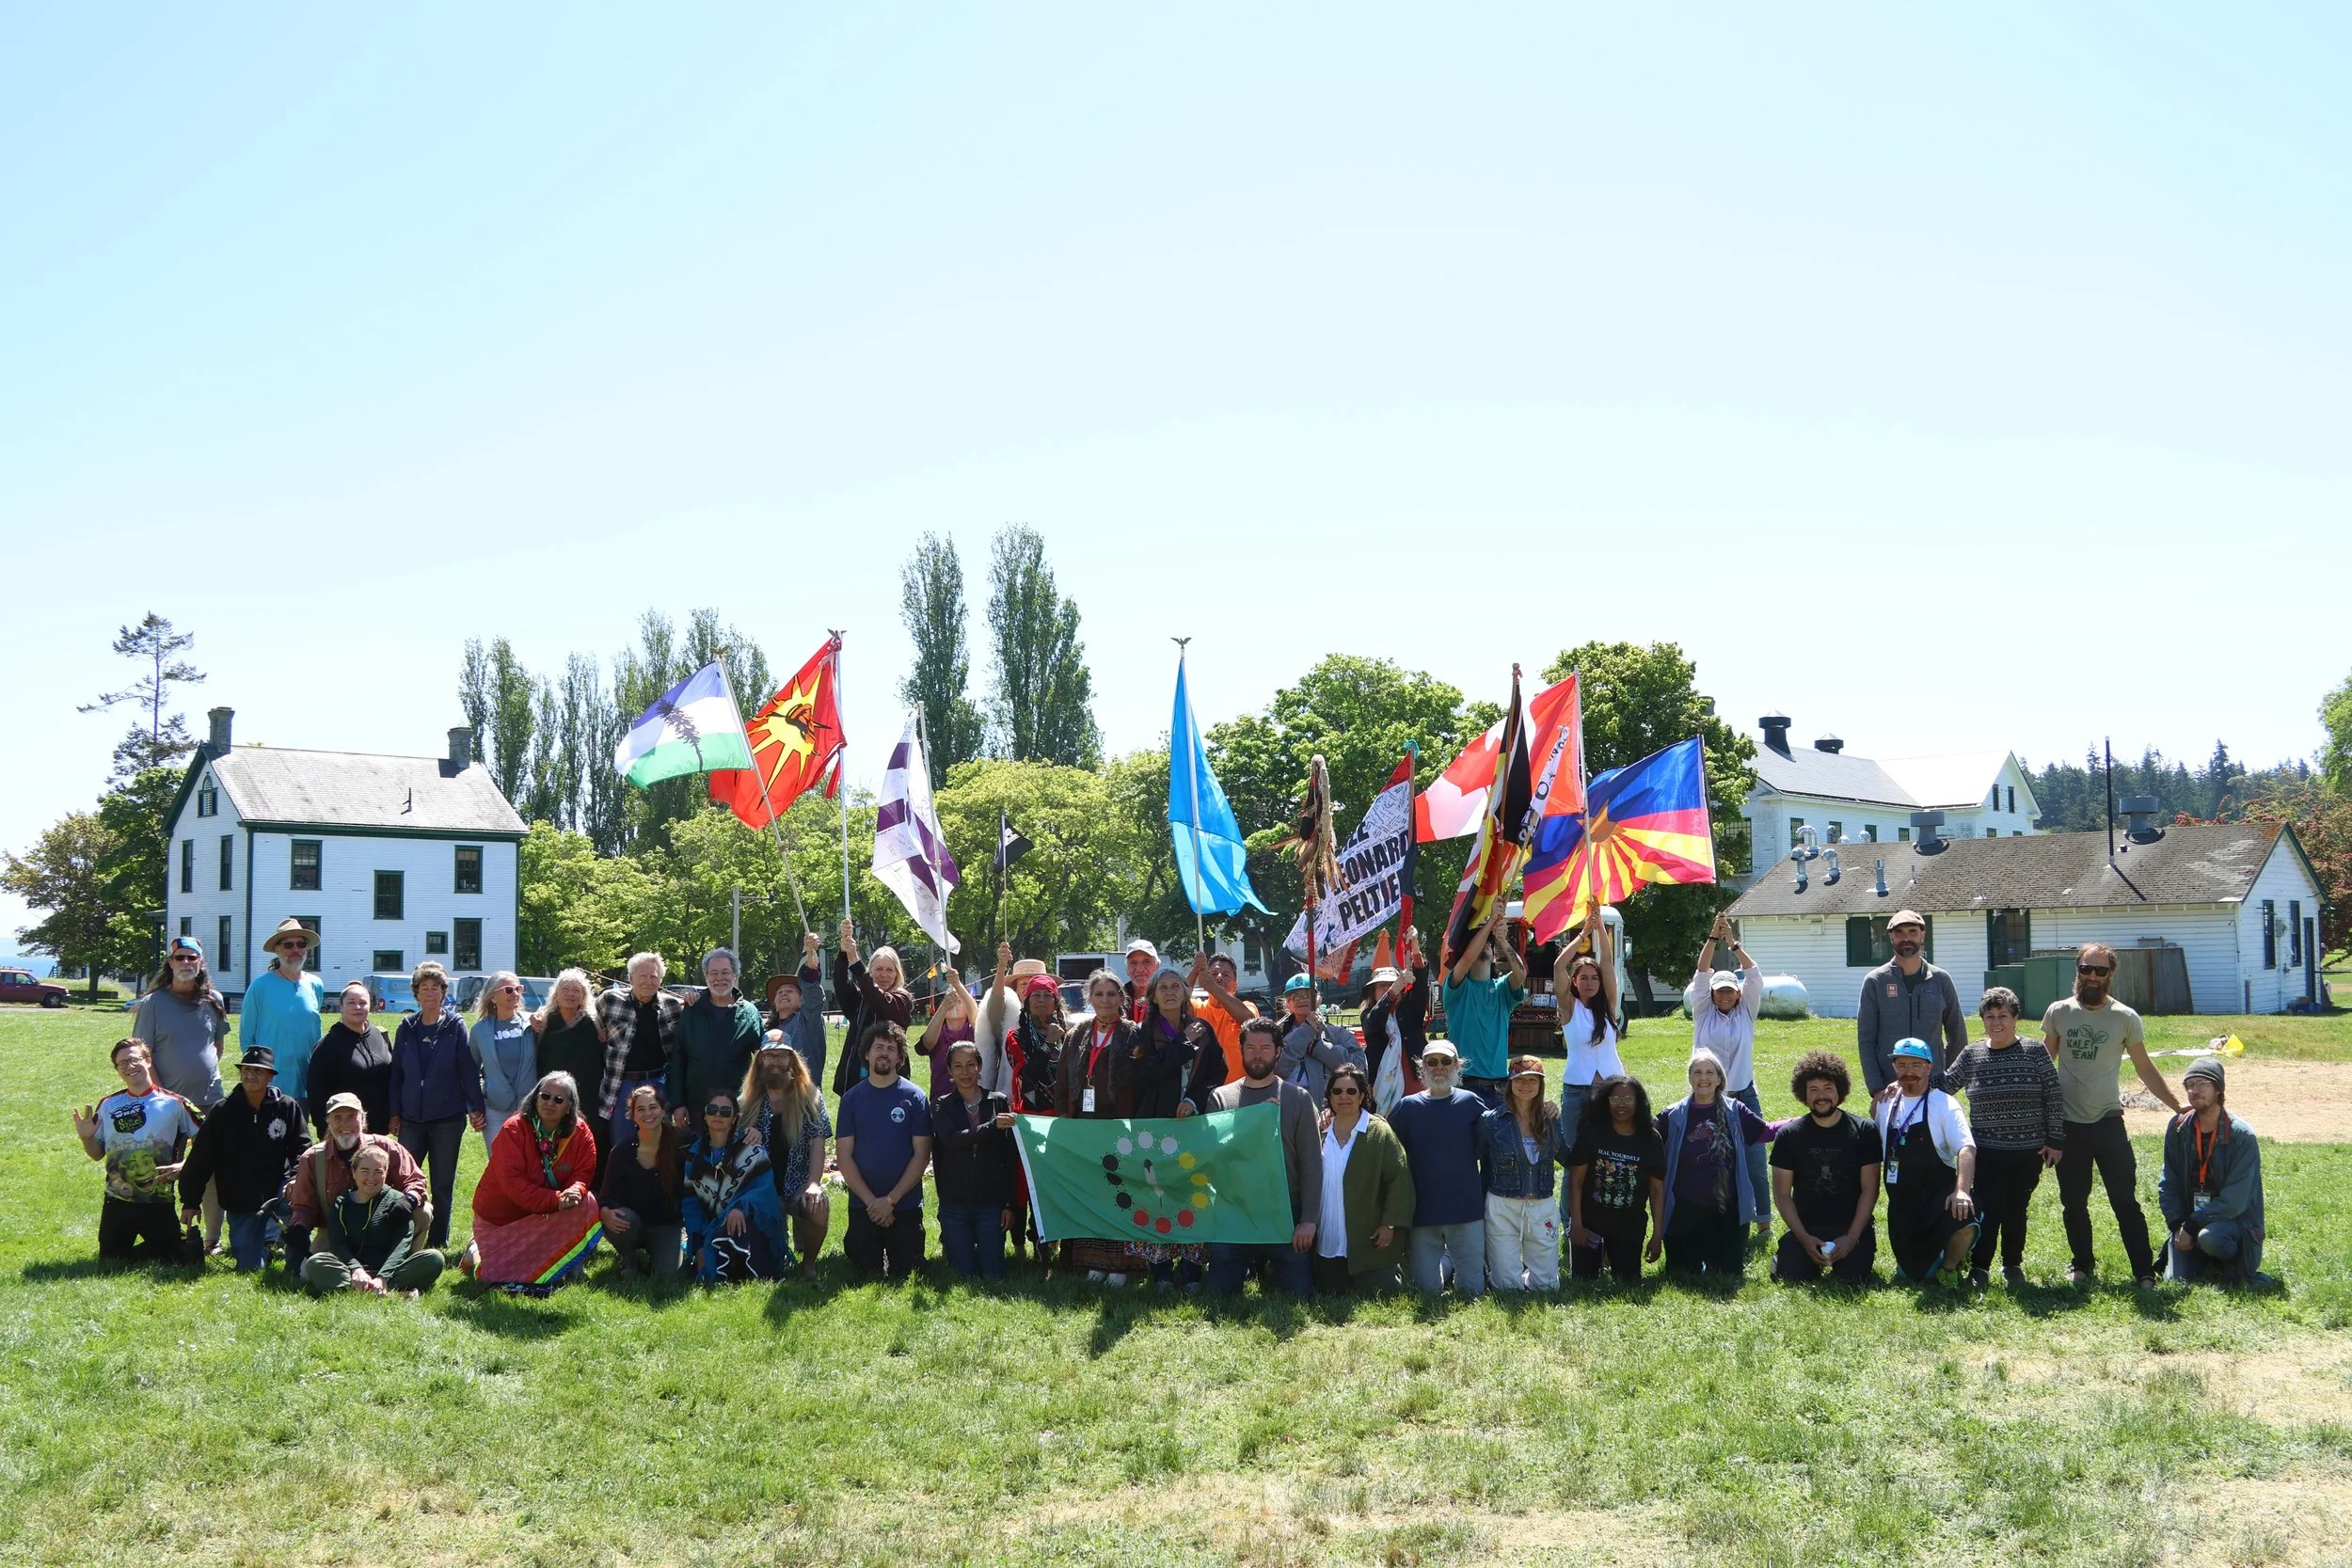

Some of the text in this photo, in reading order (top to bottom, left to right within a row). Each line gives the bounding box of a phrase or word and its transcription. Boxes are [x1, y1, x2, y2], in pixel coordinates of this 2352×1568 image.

[1333, 829, 1409, 895] EONARD
[1337, 871, 1403, 932] PELTIE
[2067, 1028, 2079, 1038] OH
[2066, 1038, 2090, 1050] KALE
[2071, 1046, 2099, 1061] YEAH!
[1611, 1150, 1642, 1163] YOURSELF
